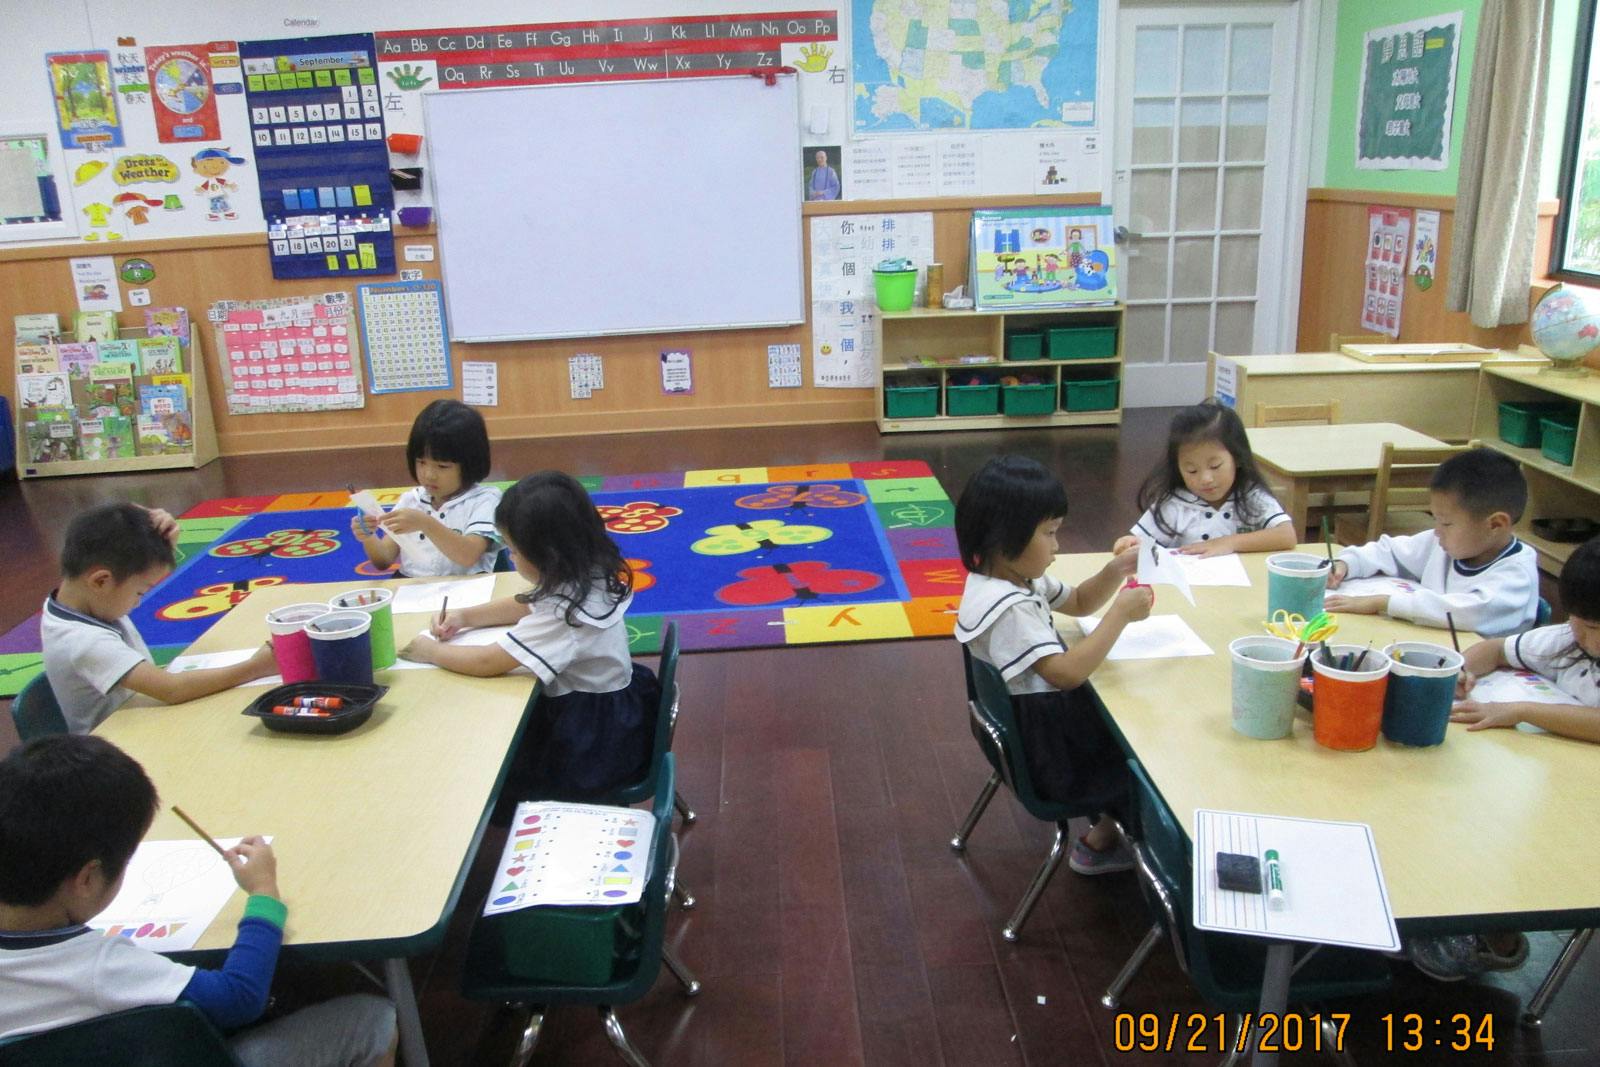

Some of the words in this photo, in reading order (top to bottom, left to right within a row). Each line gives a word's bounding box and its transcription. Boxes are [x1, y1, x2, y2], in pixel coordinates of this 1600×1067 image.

[283, 18, 318, 27] Calendar
[384, 40, 401, 53] Aa
[411, 38, 428, 52] Bb
[438, 36, 456, 50] Cc
[465, 35, 484, 49] Dd
[497, 34, 512, 48] Ee
[526, 32, 538, 46] Ff
[550, 31, 571, 47] Gg
[582, 29, 599, 43] Hh
[613, 28, 623, 42] Ii
[643, 27, 653, 43] Jj
[671, 25, 687, 39] Kk
[705, 24, 715, 38] Ll
[729, 23, 752, 37] Mm
[761, 22, 779, 36] Nn
[787, 20, 806, 35] Oo
[815, 19, 830, 36] Pp
[299, 57, 344, 67] September
[480, 65, 492, 79] Rr
[506, 64, 520, 78] Ss
[534, 63, 544, 77] Tt
[559, 61, 575, 75] Uu
[598, 59, 614, 72] Vv
[633, 58, 658, 71] Ww
[675, 56, 691, 70] Xx
[716, 54, 732, 69] Yy
[757, 52, 773, 66] Zz
[828, 65, 845, 84] 右
[367, 89, 373, 97] 2
[384, 91, 404, 111] 左
[258, 111, 264, 120] 3
[293, 110, 299, 118] 5
[329, 108, 335, 116] 7
[349, 106, 355, 115] 8
[369, 105, 375, 113] 9
[258, 134, 267, 142] 10
[279, 133, 286, 141] 11
[296, 132, 304, 140] 12
[314, 131, 322, 139] 13
[331, 130, 340, 138] 14
[124, 158, 155, 169] Dress
[119, 168, 171, 181] Weather
[276, 244, 285, 252] 17
[293, 242, 302, 250] 18
[310, 241, 318, 249] 19
[326, 240, 336, 249] 20
[343, 239, 352, 247] 21
